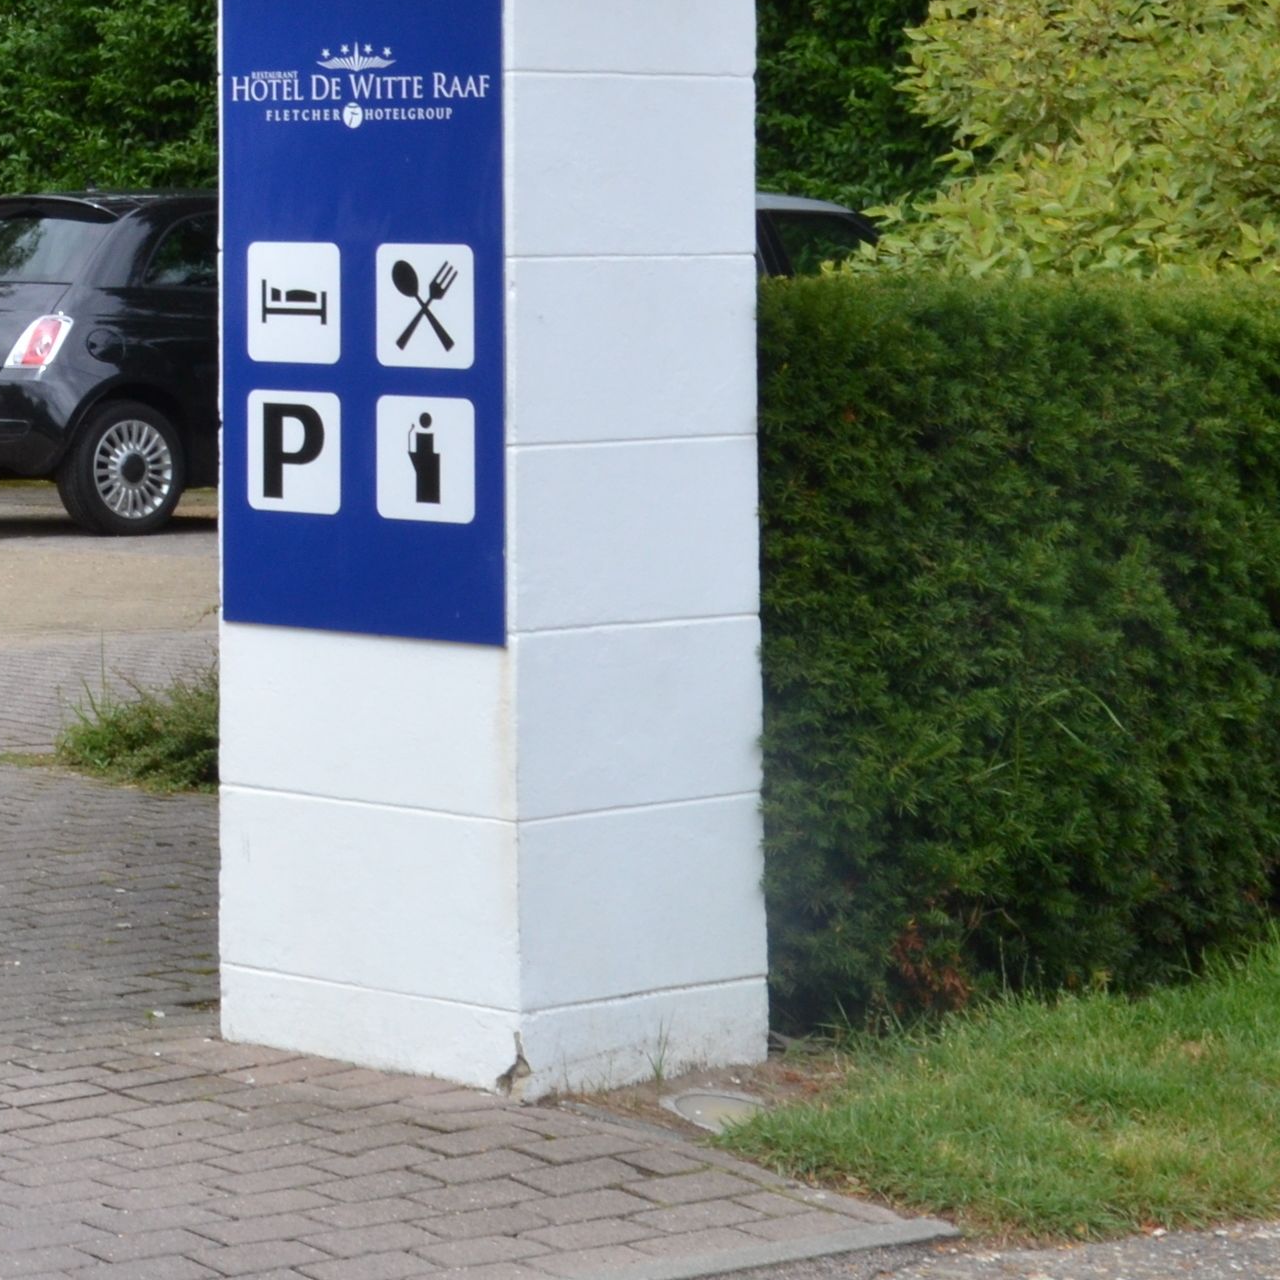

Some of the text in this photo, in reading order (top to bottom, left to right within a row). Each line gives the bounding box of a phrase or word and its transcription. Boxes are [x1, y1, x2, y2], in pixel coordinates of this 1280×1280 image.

[231, 71, 490, 102] HOTEL DE WITTE RAAF
[251, 71, 299, 80] RESTAURANT
[266, 107, 454, 122] FLETCHER HOTELGROUP
[262, 402, 325, 500] P
